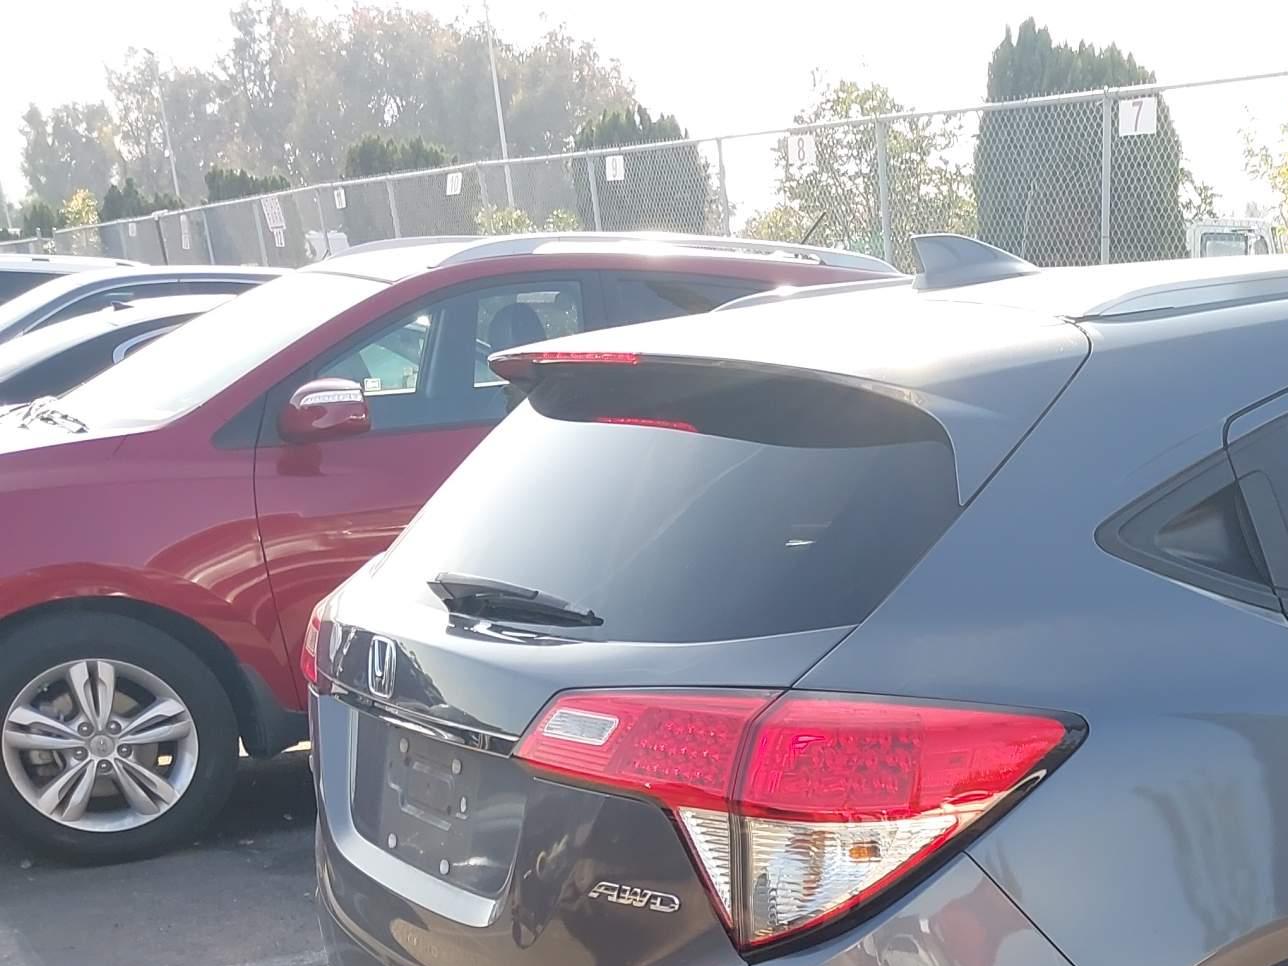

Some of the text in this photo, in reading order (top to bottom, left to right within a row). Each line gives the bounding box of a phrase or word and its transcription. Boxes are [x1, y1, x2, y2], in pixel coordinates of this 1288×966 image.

[1131, 101, 1144, 132] 7
[797, 137, 805, 161] 8
[611, 157, 618, 178] 9
[450, 175, 459, 193] 10
[588, 881, 680, 912] AWD
